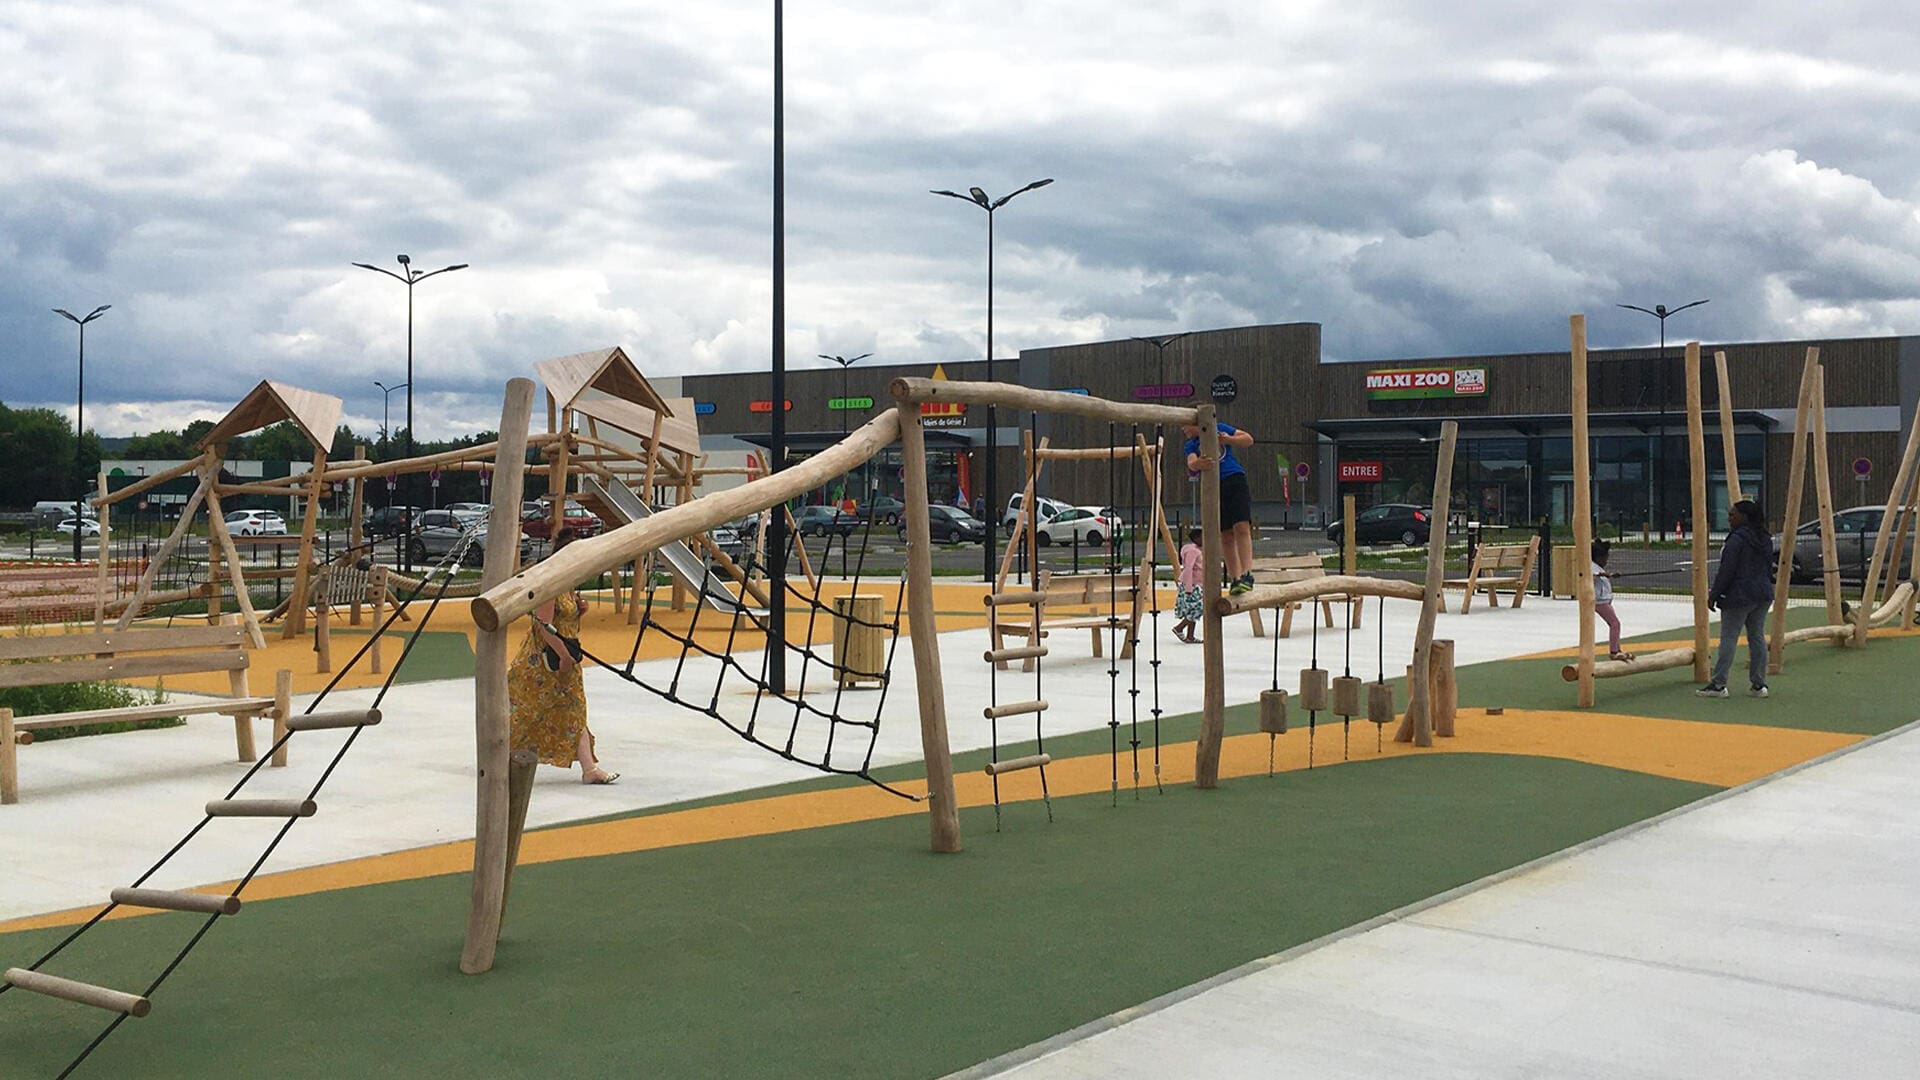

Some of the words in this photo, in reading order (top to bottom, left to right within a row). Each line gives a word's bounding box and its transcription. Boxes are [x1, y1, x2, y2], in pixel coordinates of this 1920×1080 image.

[1366, 374, 1411, 388] MAXI
[1414, 372, 1450, 386] ZOO
[1342, 466, 1378, 476] ENTREE
